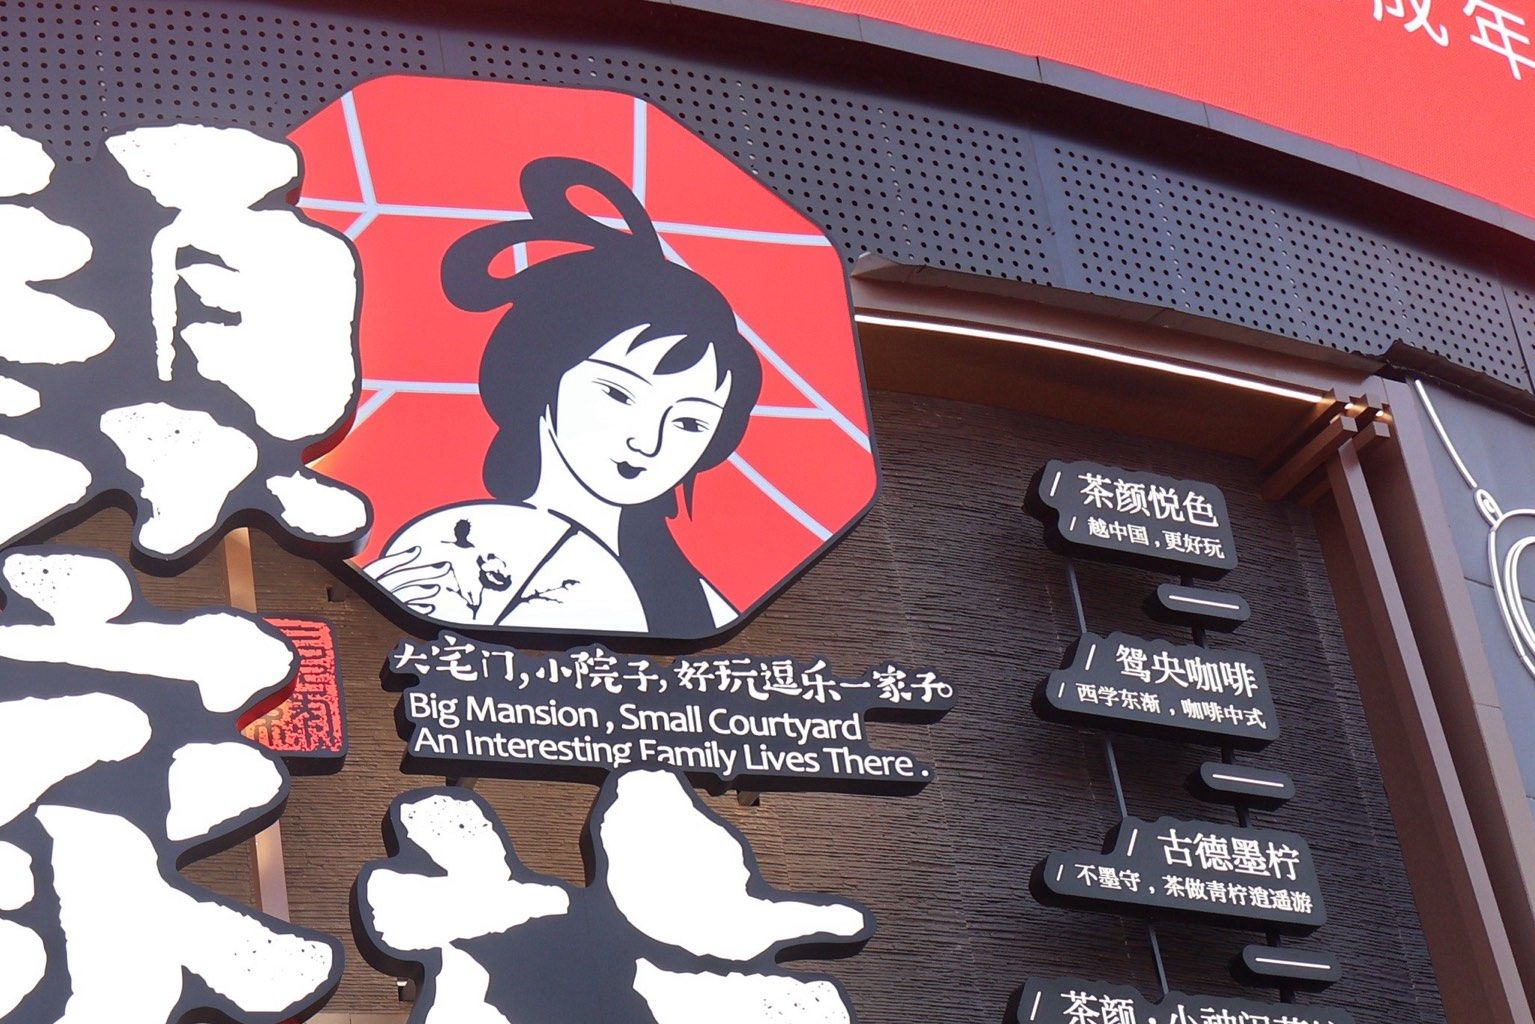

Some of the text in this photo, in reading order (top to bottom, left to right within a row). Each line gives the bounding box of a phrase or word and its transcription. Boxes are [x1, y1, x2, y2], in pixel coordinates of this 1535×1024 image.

[1078, 472, 1219, 528] 茶颜悦色
[1116, 644, 1259, 699] 鸳央咖啡
[410, 693, 459, 728] Big
[621, 704, 703, 734] Small
[709, 709, 862, 746] Courtyard
[414, 728, 458, 755] An
[466, 731, 632, 769] Interesting
[640, 739, 738, 776] Family
[744, 746, 819, 774] Lives
[1157, 828, 1300, 882] 古德墨柠
